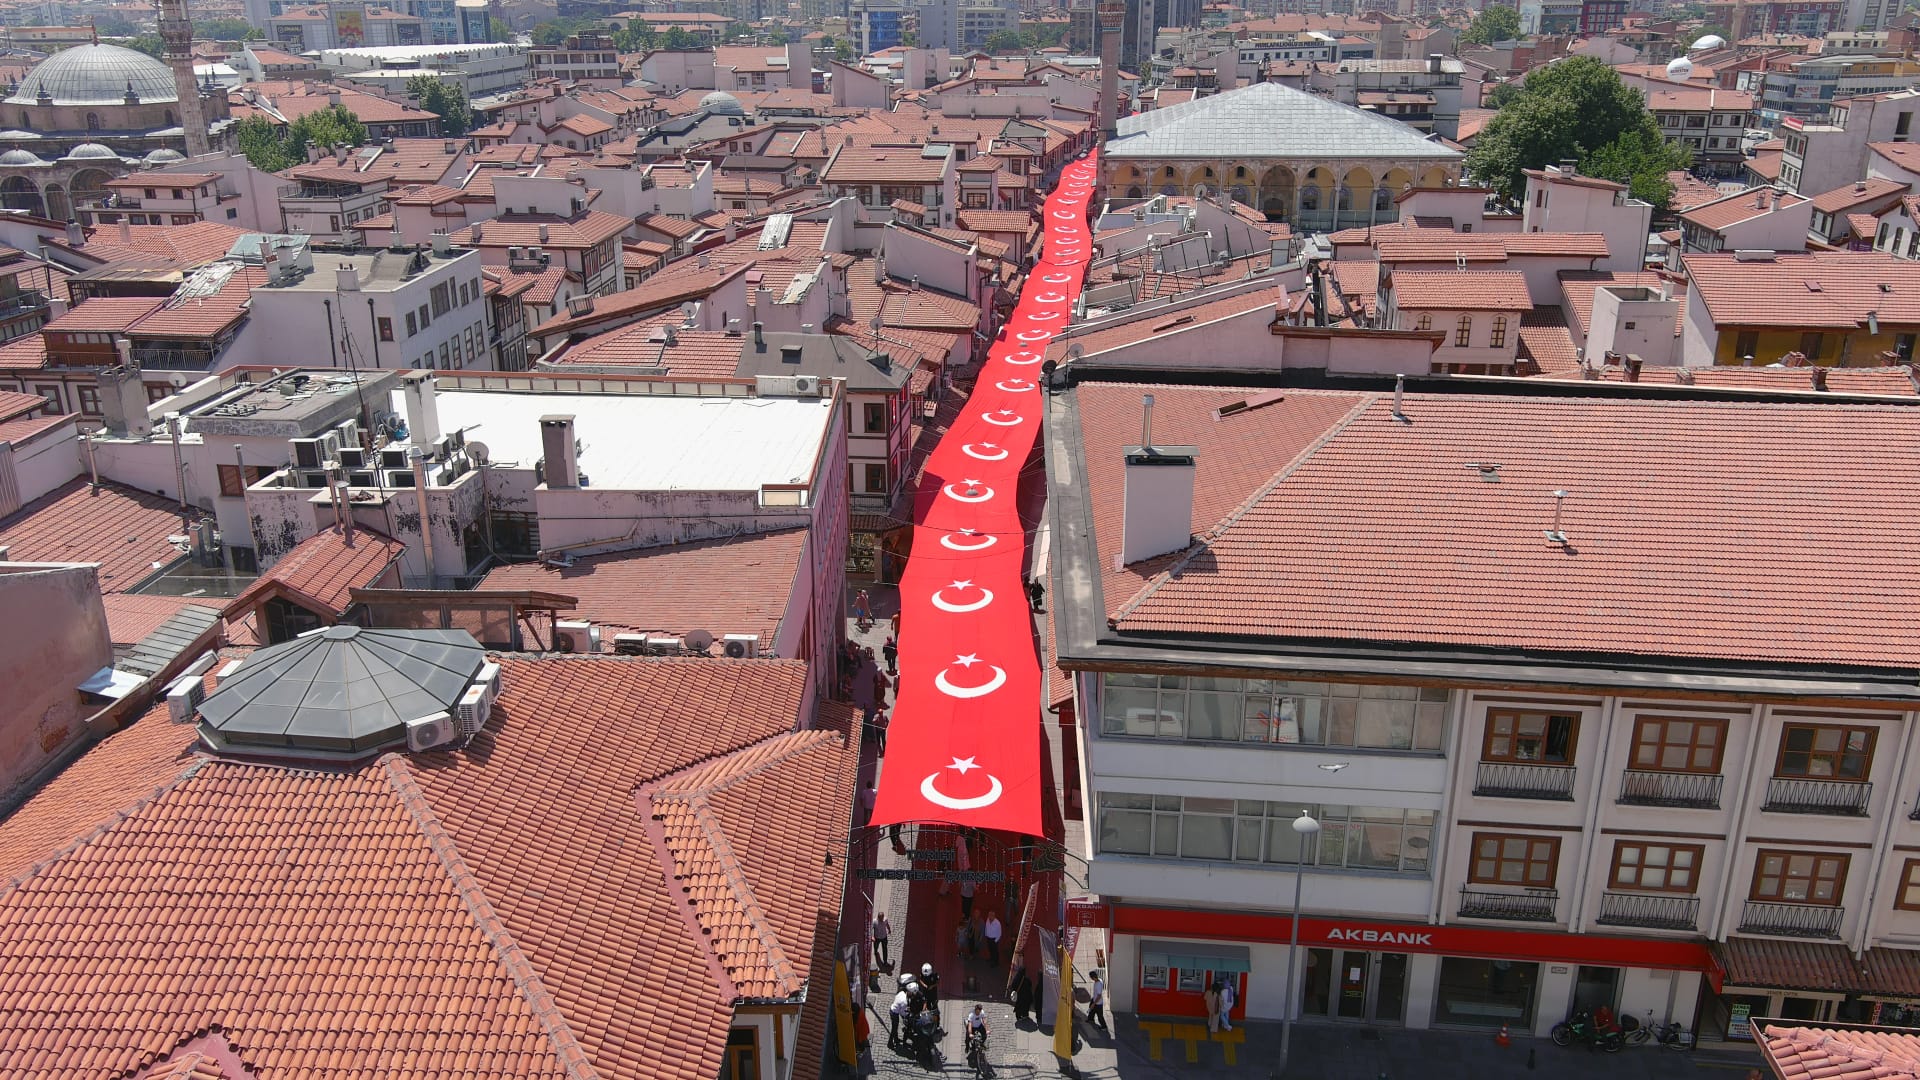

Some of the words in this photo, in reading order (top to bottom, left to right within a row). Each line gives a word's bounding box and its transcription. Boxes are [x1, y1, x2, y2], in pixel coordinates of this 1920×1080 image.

[906, 848, 956, 862] TARİHİ
[944, 868, 1006, 883] ÇARŞISI
[1327, 928, 1433, 945] AKBANK
